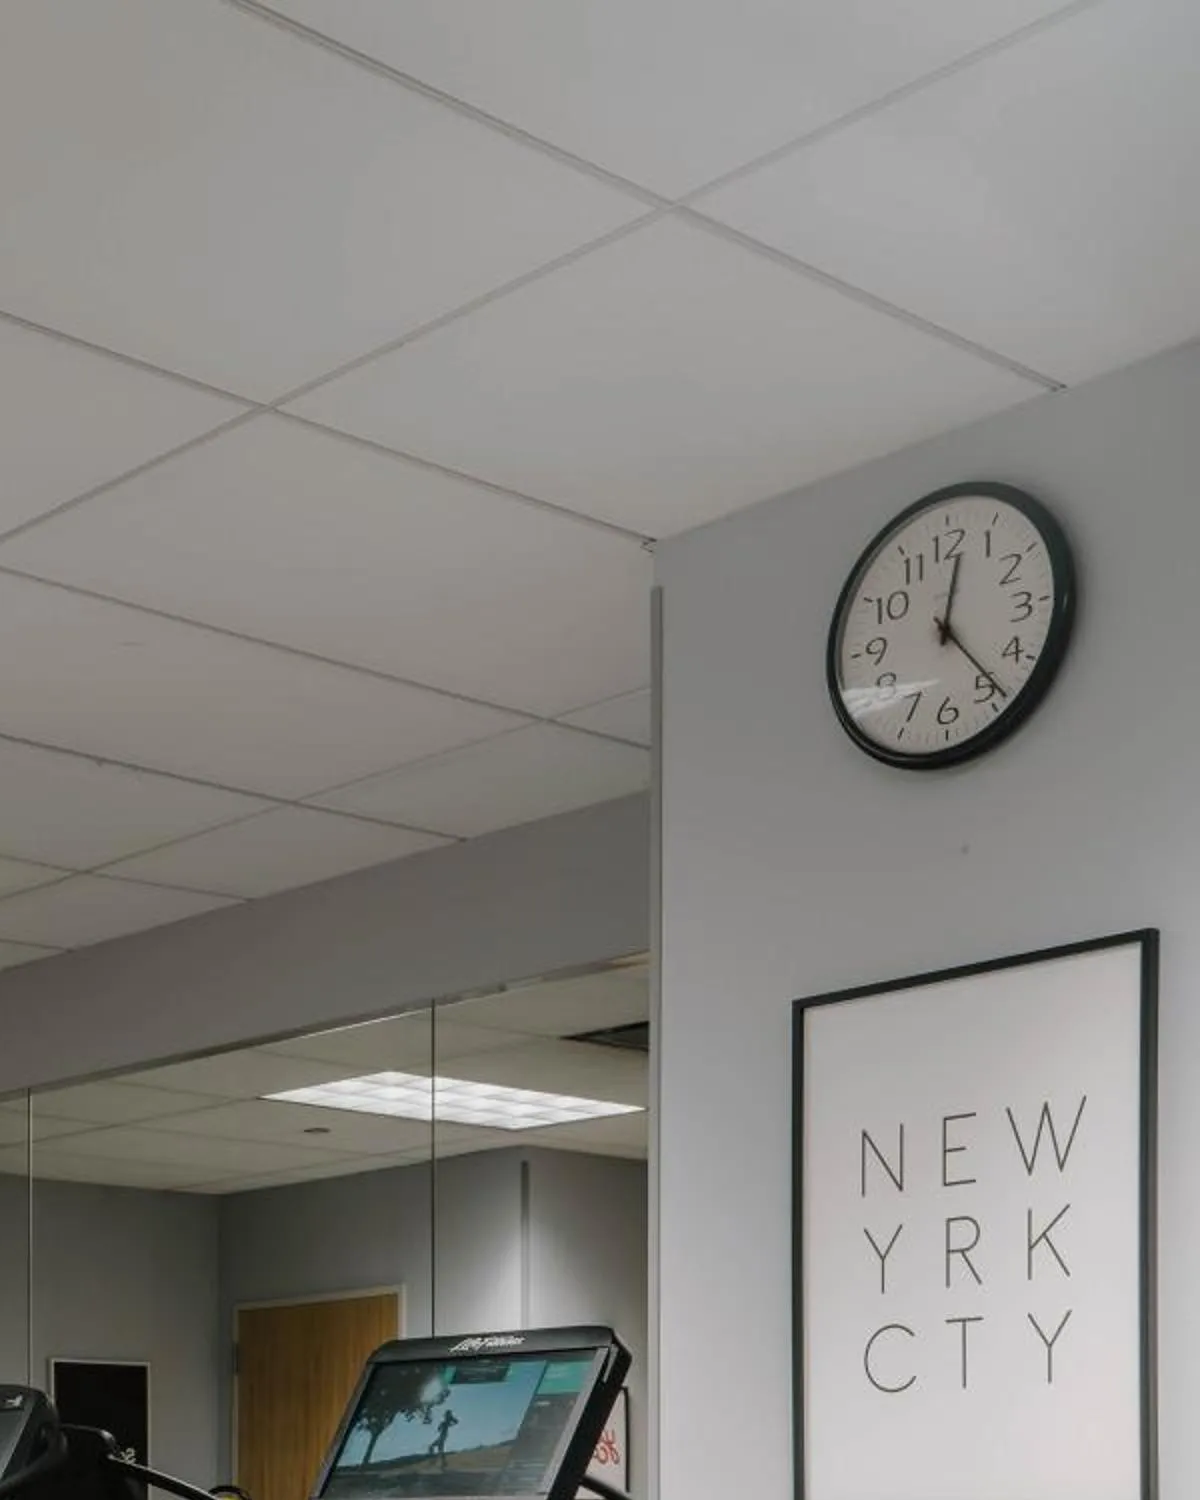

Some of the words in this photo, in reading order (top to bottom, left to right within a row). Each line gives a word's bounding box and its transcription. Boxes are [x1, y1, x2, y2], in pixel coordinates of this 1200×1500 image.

[932, 528, 966, 563] 12
[984, 529, 992, 557] 1
[903, 553, 924, 585] 11
[999, 553, 1022, 585] 2
[875, 590, 910, 625] 10
[1010, 591, 1033, 622] 3
[865, 637, 888, 666] 9
[1001, 636, 1023, 663] 4
[974, 671, 996, 703] 5
[903, 691, 923, 722] 7
[937, 696, 959, 725] 6
[861, 1094, 1087, 1198] NEW
[862, 1203, 1072, 1294] YRK
[862, 1308, 1074, 1393] CTY
